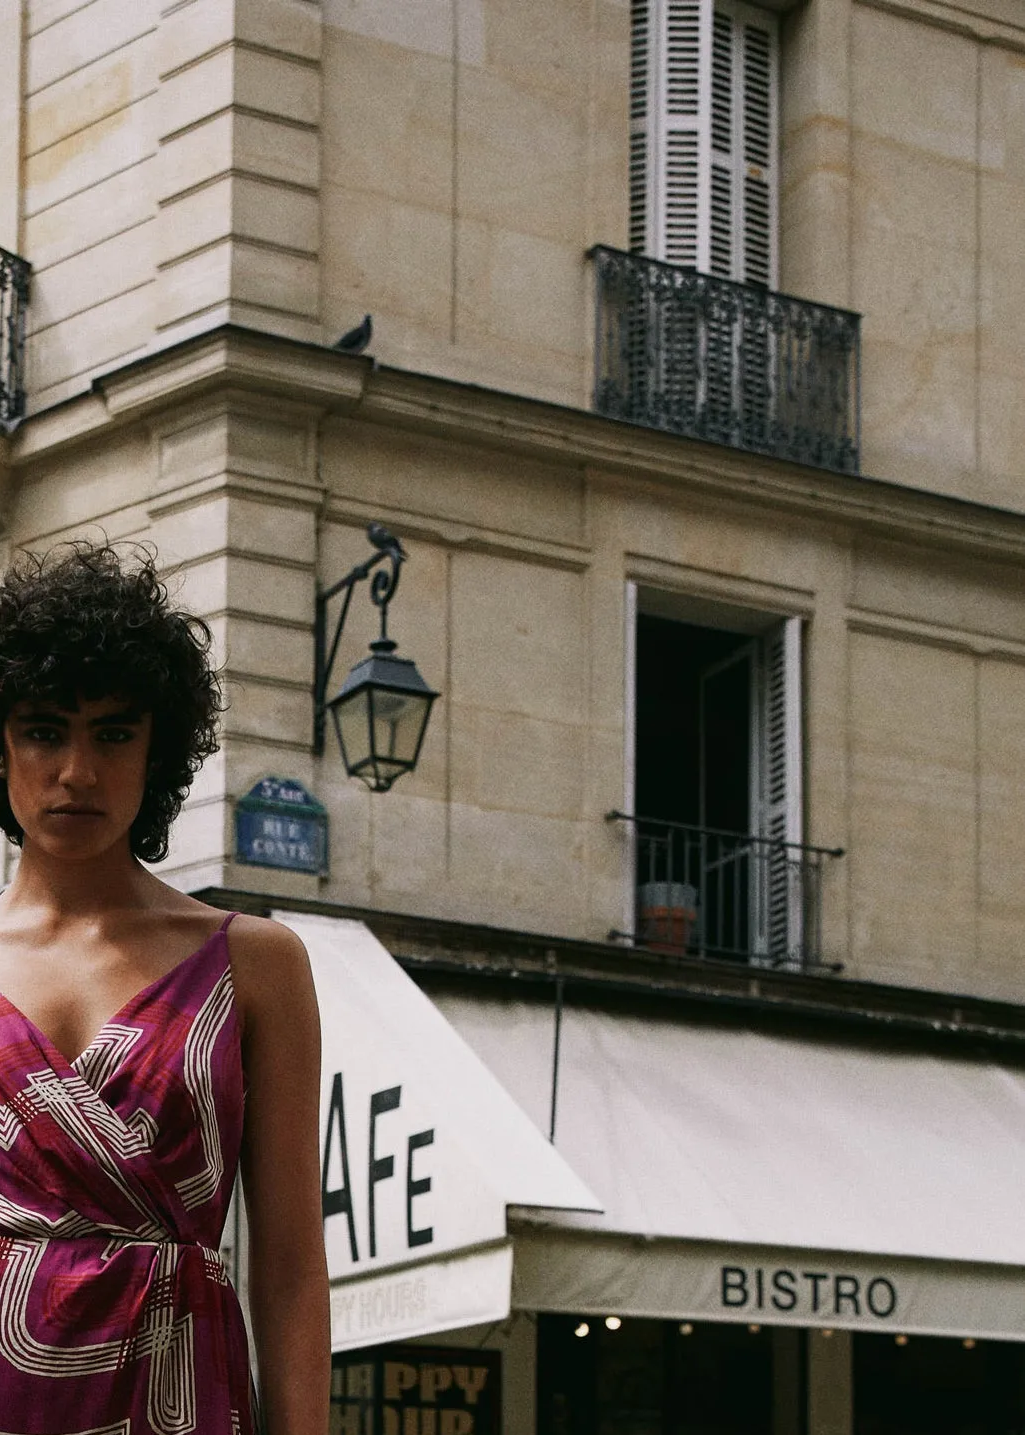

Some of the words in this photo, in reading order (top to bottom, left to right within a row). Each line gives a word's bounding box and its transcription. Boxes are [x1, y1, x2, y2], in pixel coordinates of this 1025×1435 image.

[263, 818, 301, 840] RUE
[321, 1072, 435, 1262] AFE
[720, 1265, 897, 1319] BISTRO
